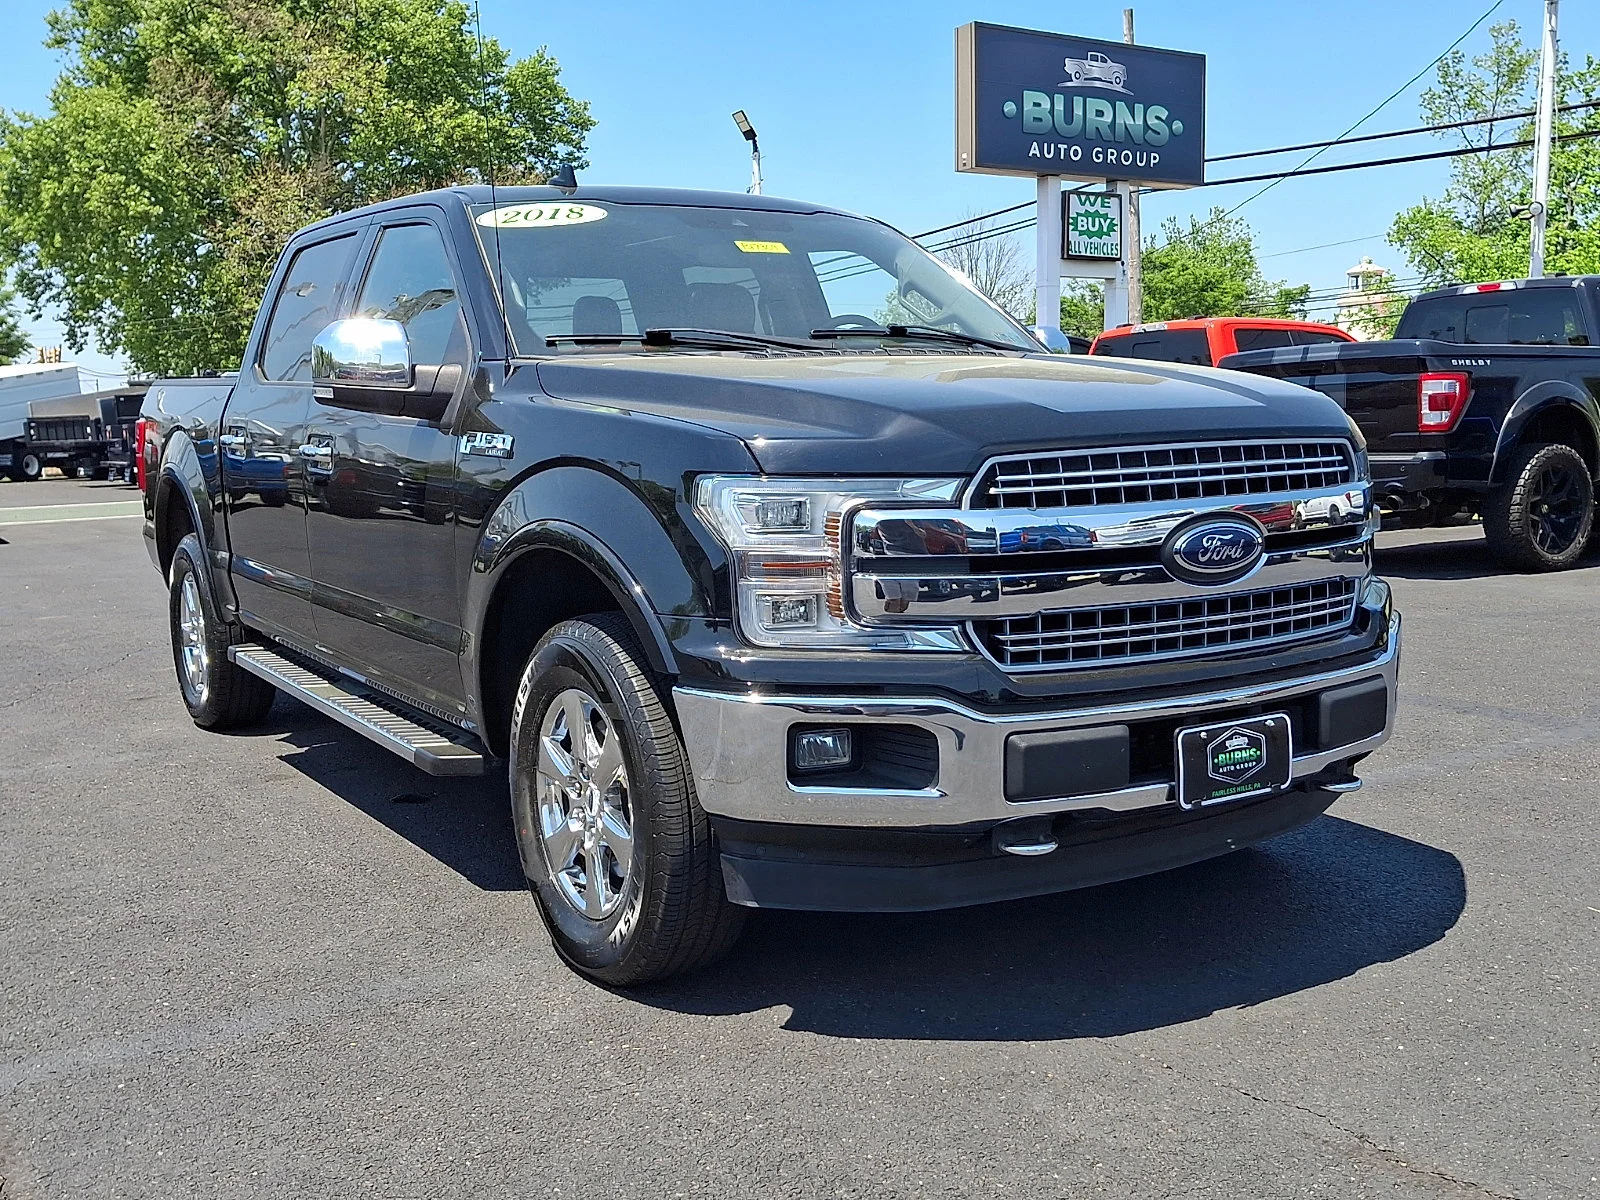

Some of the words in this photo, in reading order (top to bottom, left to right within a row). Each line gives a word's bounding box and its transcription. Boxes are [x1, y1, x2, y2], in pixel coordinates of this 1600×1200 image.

[1022, 90, 1170, 147] BURNS
[1028, 141, 1082, 161] AUTO
[1092, 147, 1160, 168] GROUP
[1075, 194, 1111, 208] WE
[501, 206, 584, 223] 2018
[1077, 216, 1111, 232] BUY
[1069, 240, 1081, 254] ALL
[1083, 241, 1119, 256] VEHICLES
[1198, 534, 1246, 562] Ford
[1218, 747, 1257, 766] BURNS
[1219, 765, 1235, 773] AUTO
[1235, 761, 1256, 770] GROUP
[1211, 786, 1236, 797] FAIRLESS
[1253, 782, 1261, 790] PA
